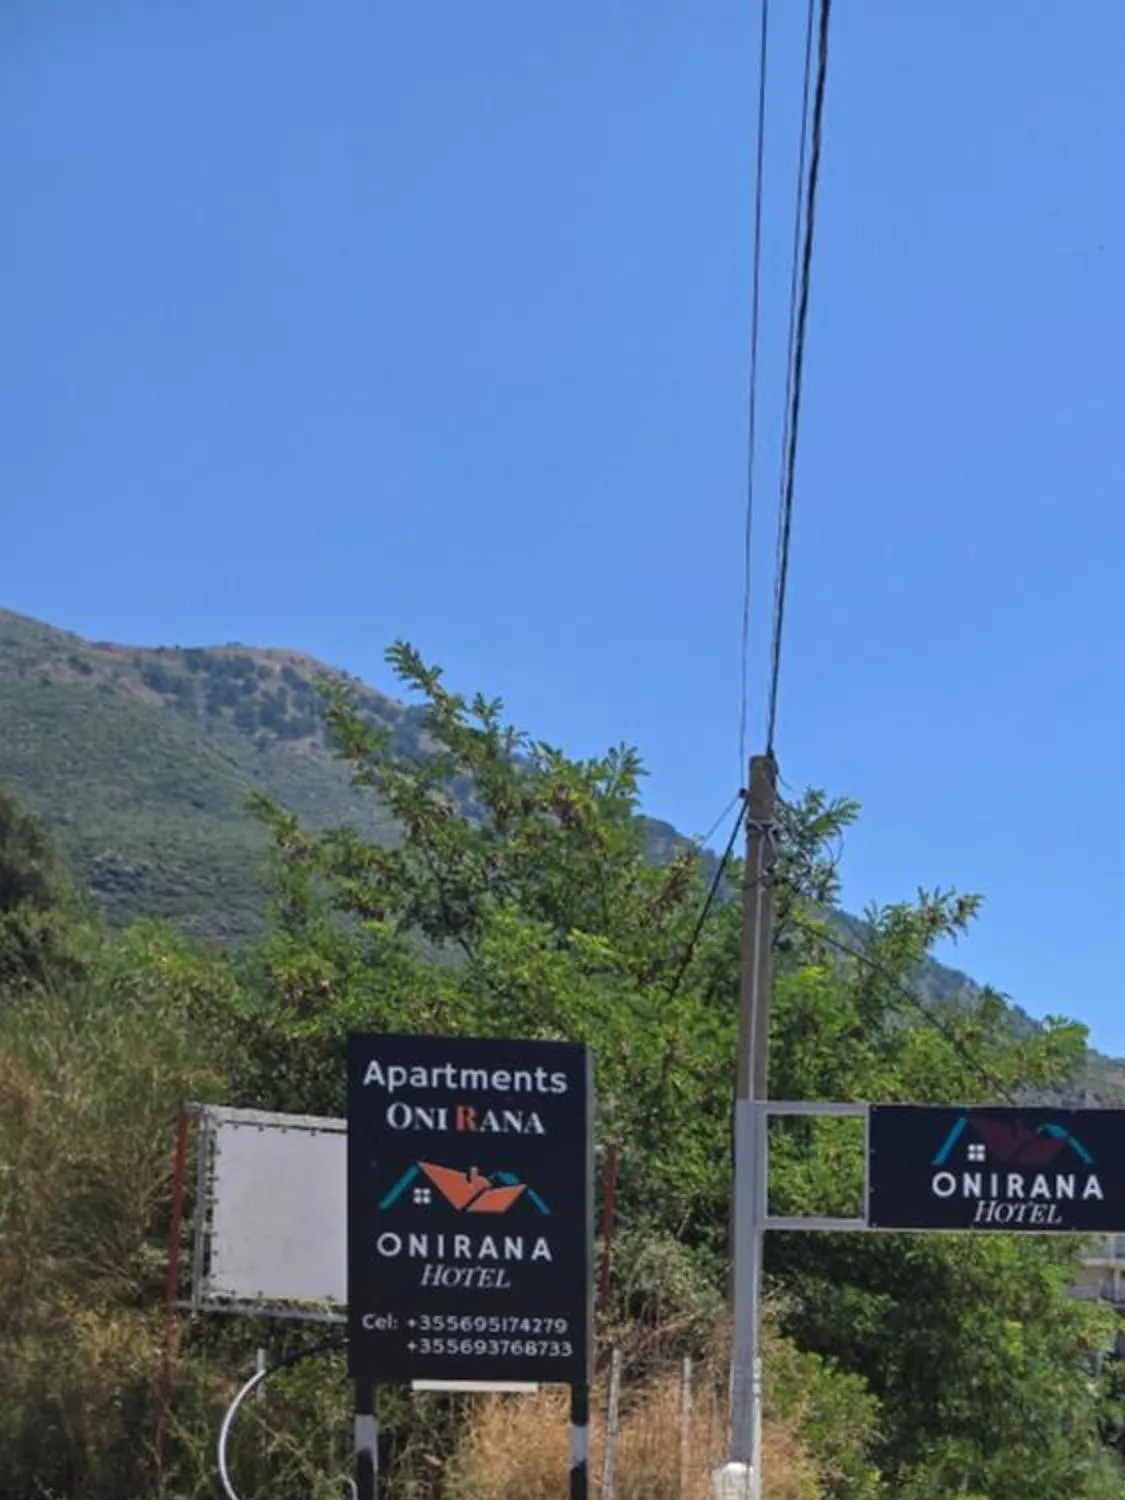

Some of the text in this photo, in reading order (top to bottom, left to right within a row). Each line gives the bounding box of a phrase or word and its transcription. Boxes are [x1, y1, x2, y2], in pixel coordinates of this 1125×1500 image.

[362, 1060, 569, 1094] Apartments
[931, 1171, 1104, 1200] ONIRANA
[377, 1232, 553, 1262] ONIRANA
[420, 1264, 511, 1289] HOTEL
[361, 1312, 569, 1335] Cel: +355695174279
[407, 1337, 573, 1358] +355693768733
